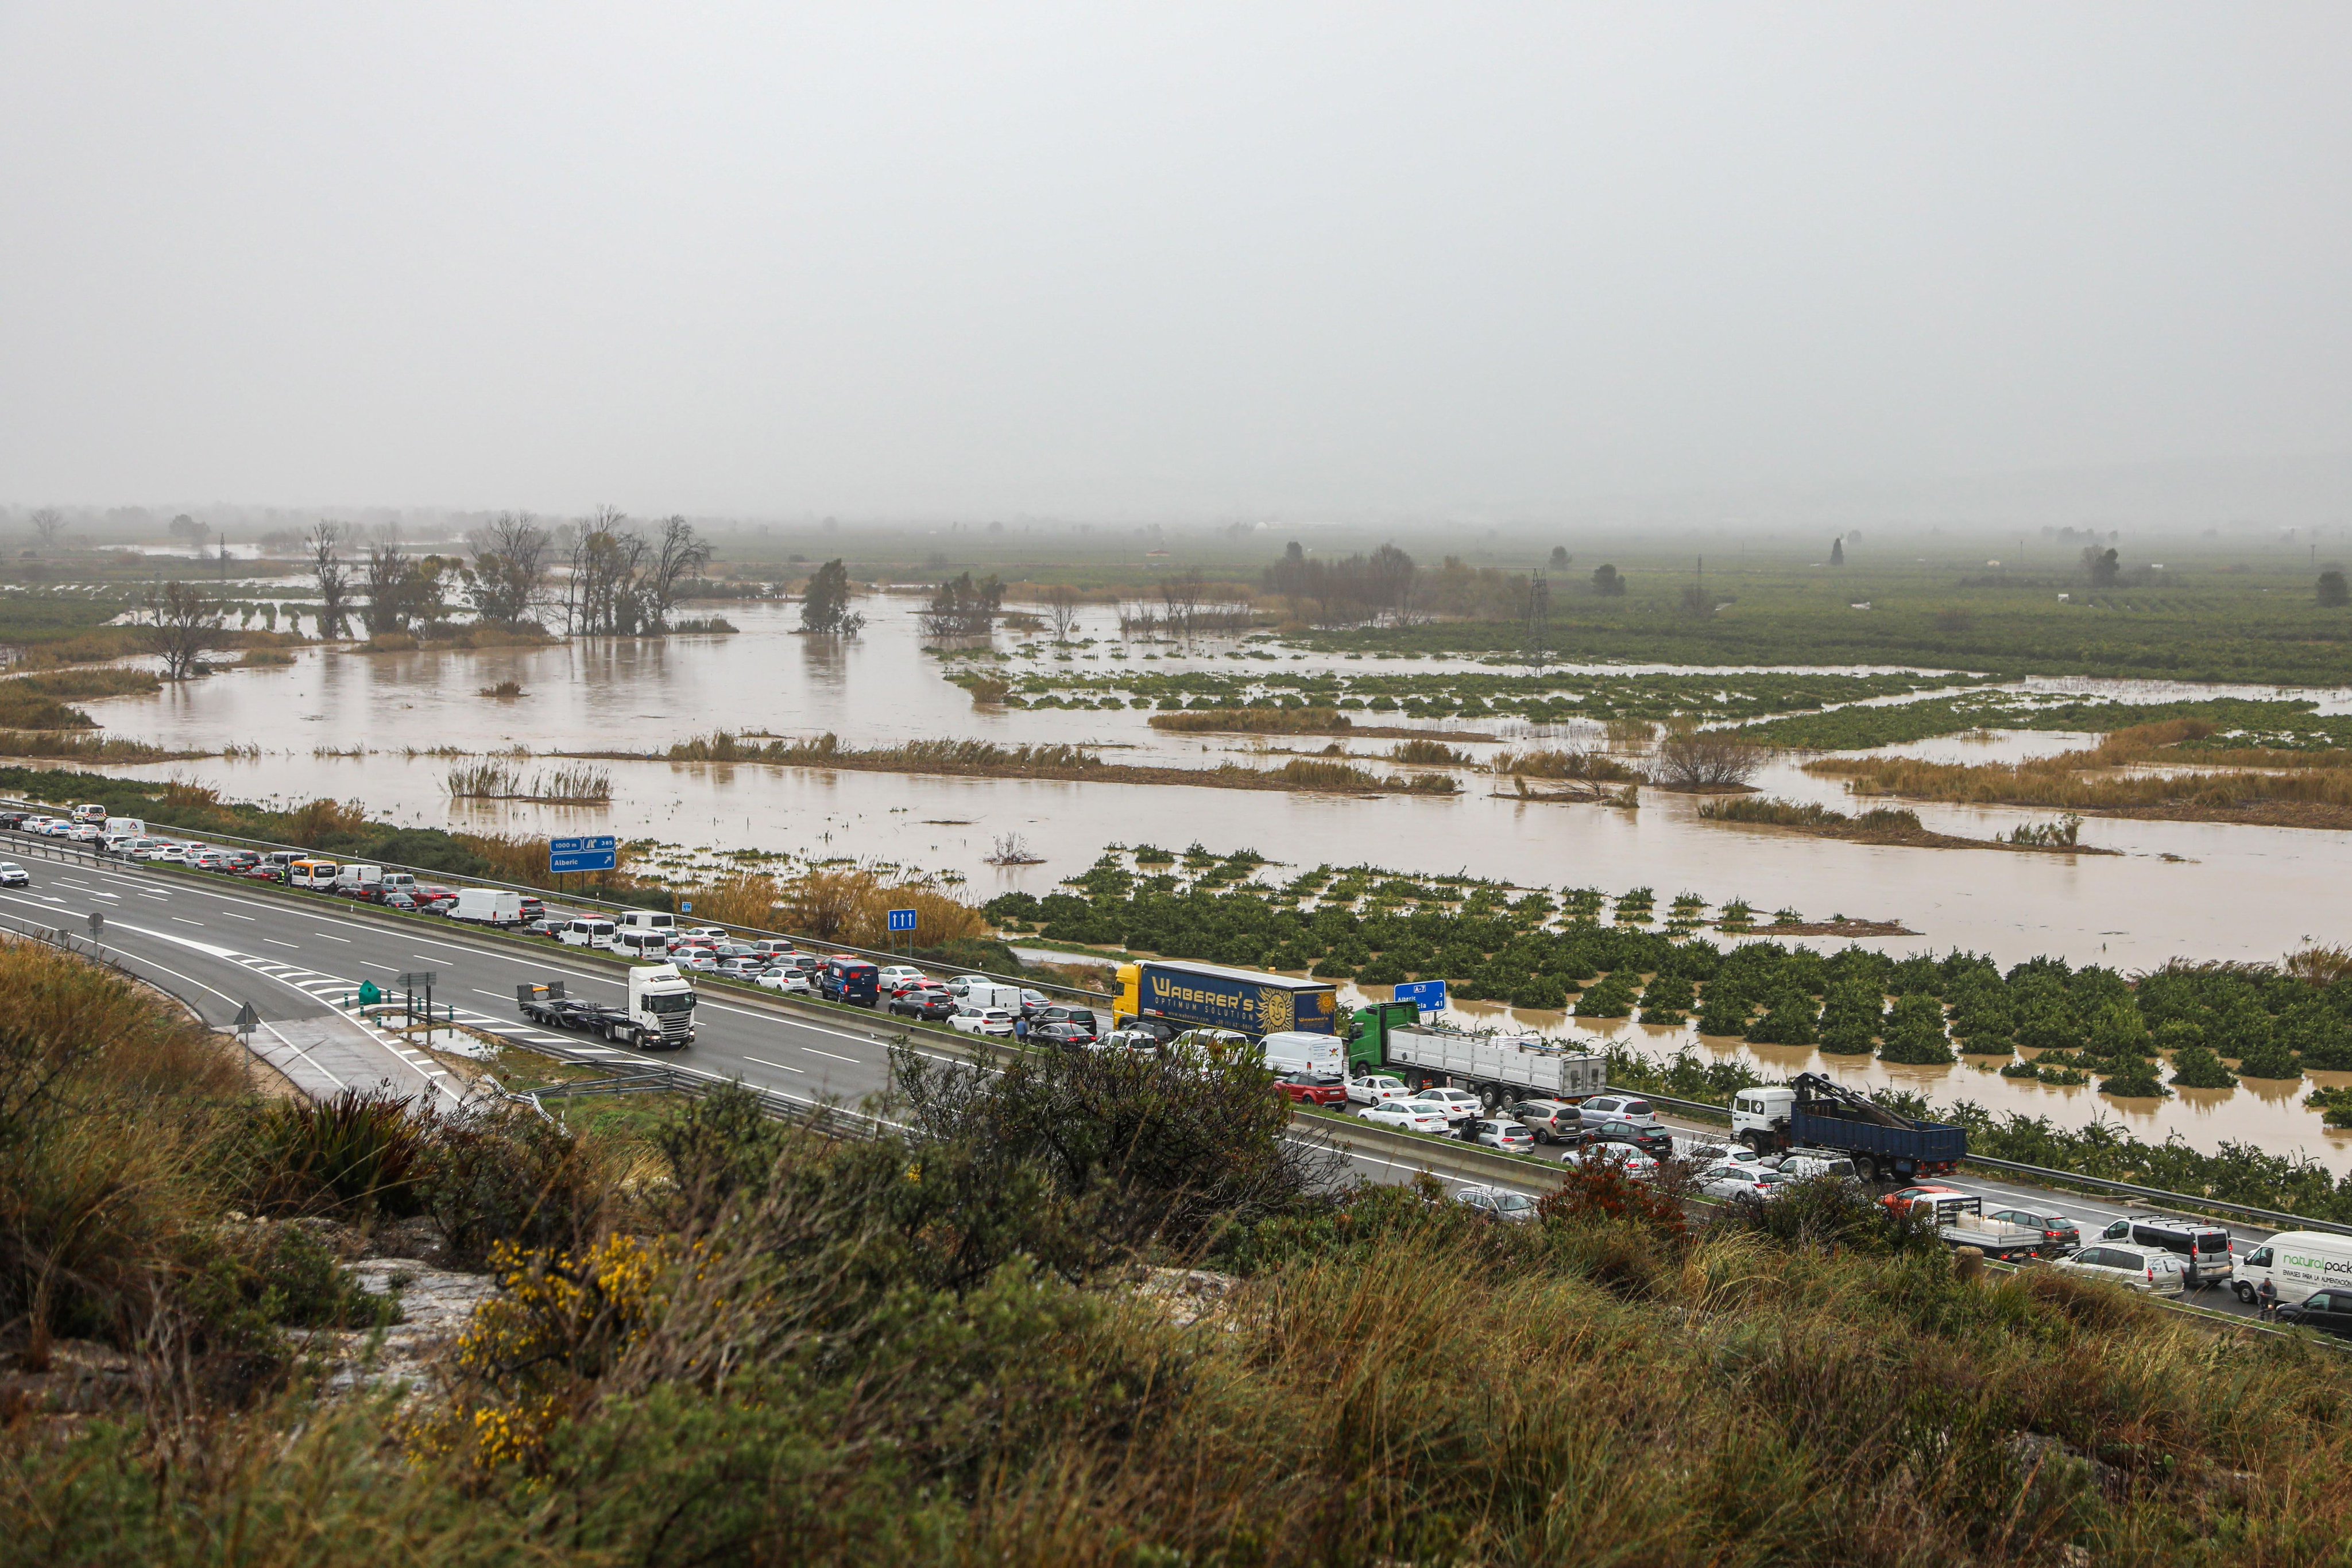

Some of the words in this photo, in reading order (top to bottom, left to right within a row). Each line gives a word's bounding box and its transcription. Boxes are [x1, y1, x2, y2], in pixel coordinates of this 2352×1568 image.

[1155, 997, 1197, 1011] OPTIMUM
[1205, 1006, 1253, 1021] SOLUTION
[2283, 1269, 2301, 1278] ENVASES
[2321, 1276, 2352, 1286] ALIMENTACIÓN
